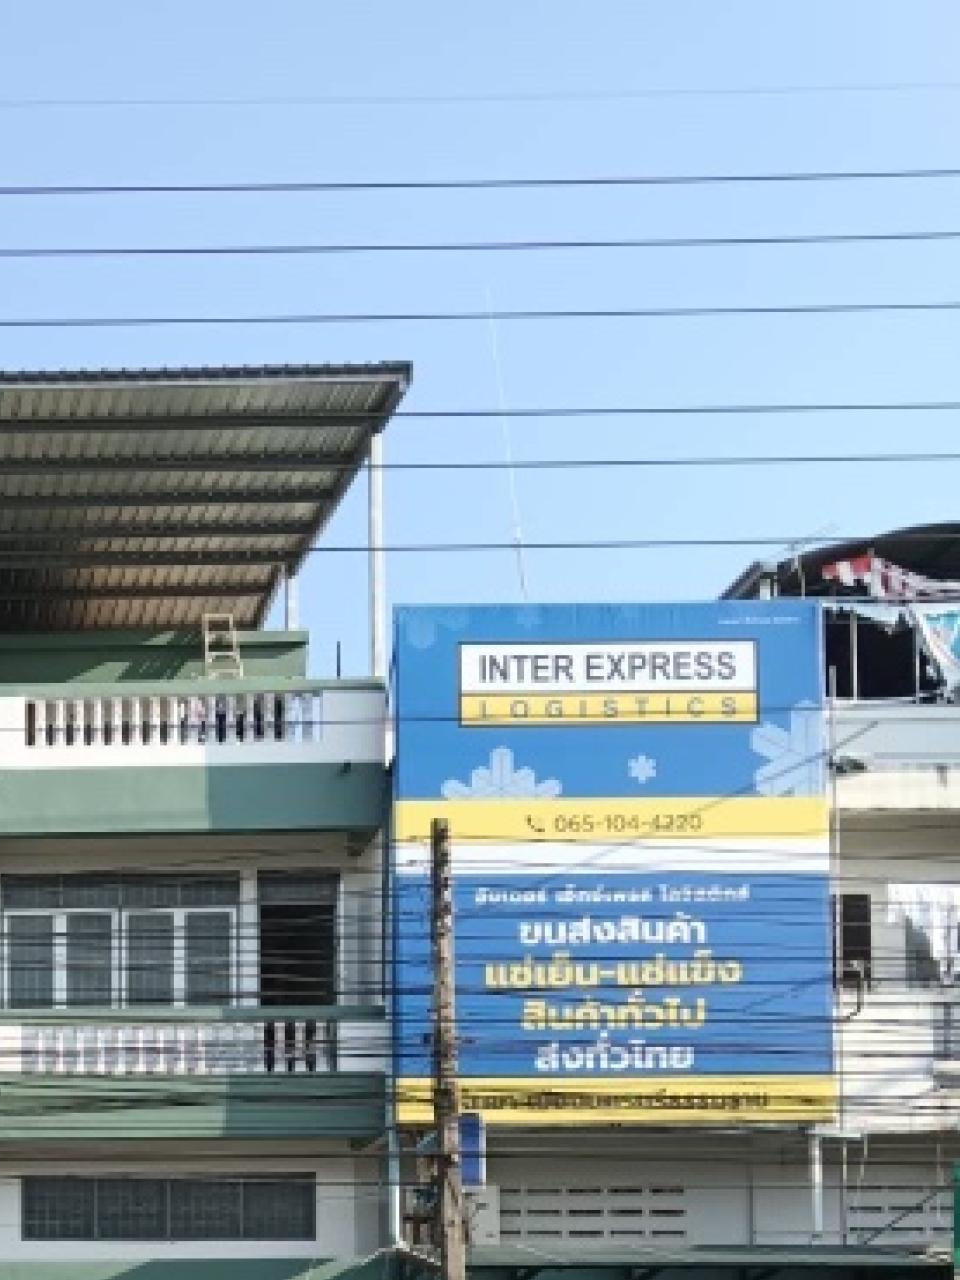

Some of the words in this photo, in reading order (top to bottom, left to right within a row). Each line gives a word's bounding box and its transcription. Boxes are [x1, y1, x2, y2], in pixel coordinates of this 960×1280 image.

[478, 654, 574, 683] INTER
[585, 651, 737, 681] EXPRESS
[478, 696, 738, 719] LOGISTICS
[519, 911, 707, 944] ขนส่งสินค้า
